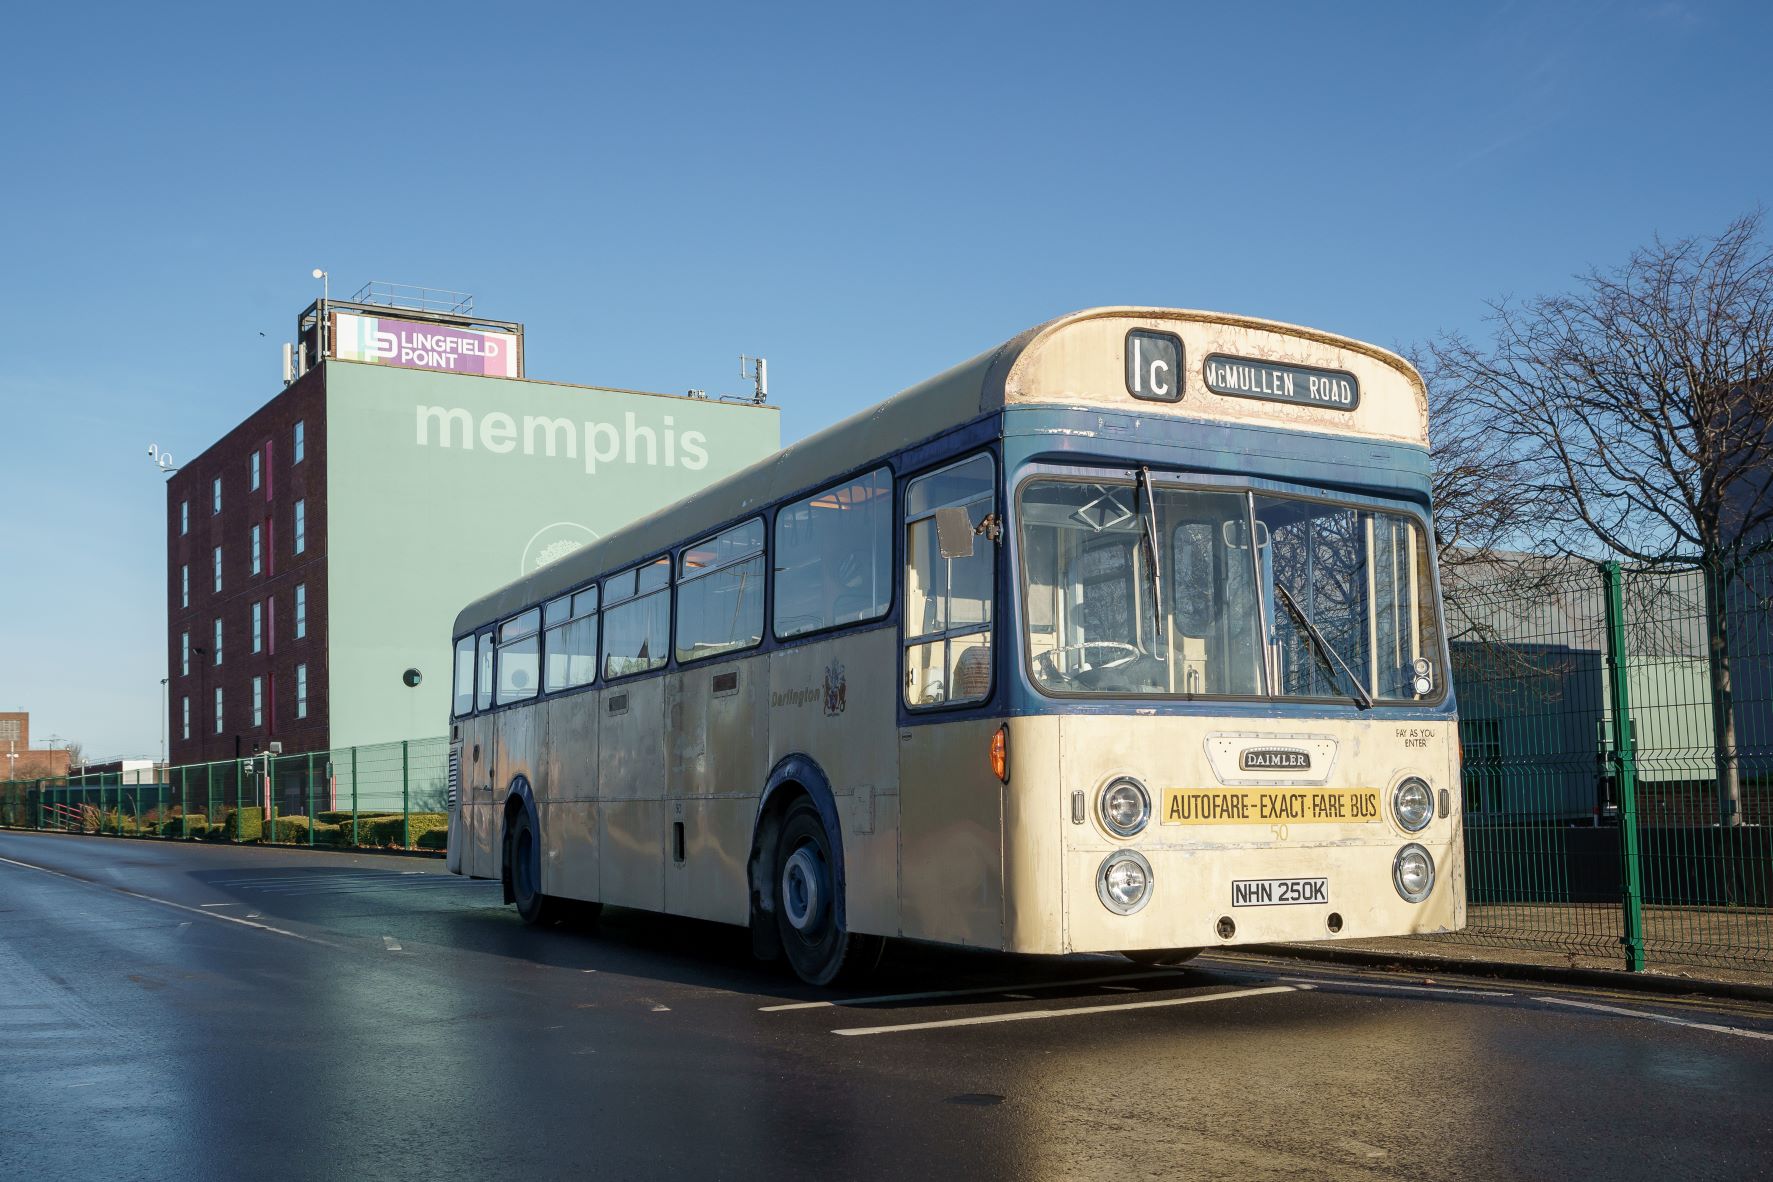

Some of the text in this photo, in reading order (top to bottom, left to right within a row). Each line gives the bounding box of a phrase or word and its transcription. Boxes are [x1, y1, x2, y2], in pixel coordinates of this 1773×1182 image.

[401, 332, 499, 358] LINGFIELD
[401, 350, 458, 369] POINT
[1309, 376, 1351, 404] ROAD
[416, 404, 709, 475] memphis
[1395, 728, 1435, 738] PAY AS YOU
[1404, 738, 1427, 748] ENTER
[1247, 753, 1307, 766] DAIMLER
[1350, 793, 1377, 818] BUS
[1270, 823, 1289, 841] 50
[1235, 881, 1326, 904] NHN 250K
